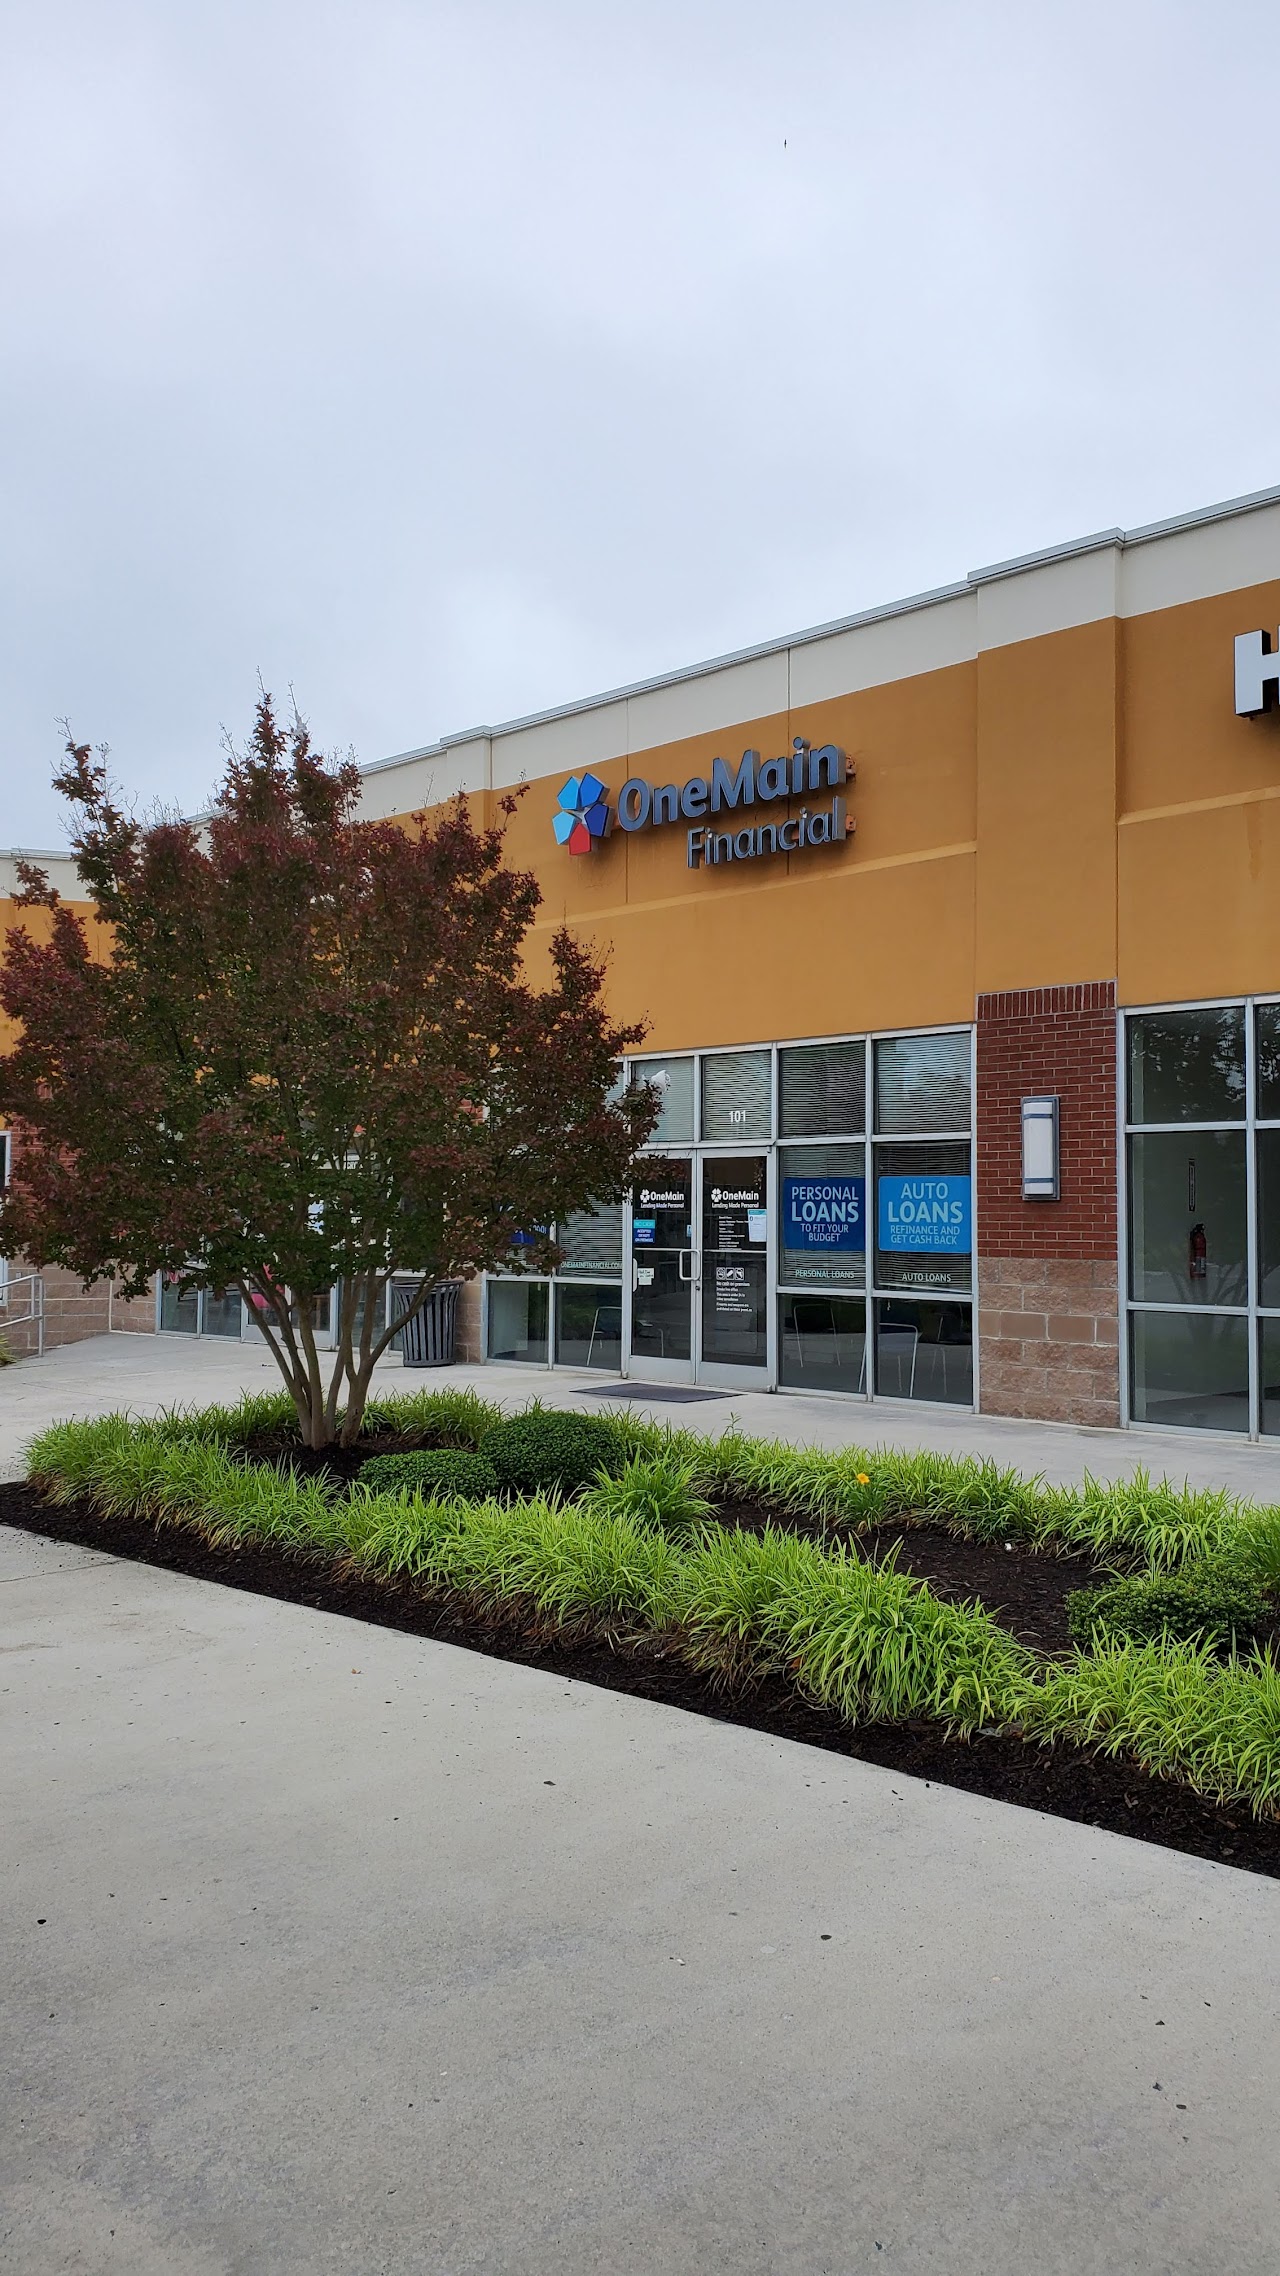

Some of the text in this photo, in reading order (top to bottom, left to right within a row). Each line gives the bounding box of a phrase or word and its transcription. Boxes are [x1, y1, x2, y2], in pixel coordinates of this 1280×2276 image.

[617, 737, 844, 832] OneMain
[687, 796, 845, 868] Financial
[729, 1110, 746, 1123] 101
[650, 1191, 685, 1201] OneMain
[722, 1190, 759, 1201] OneMain
[791, 1186, 859, 1201] PERSONAL
[900, 1182, 949, 1200] AUTO
[791, 1201, 859, 1223] LOANS
[888, 1200, 963, 1224] LOANS
[800, 1223, 849, 1234] TO FIT YOUR
[890, 1224, 960, 1236] REFINANCE AND
[808, 1232, 841, 1242] BUDGET
[890, 1234, 958, 1246] GET CASH BACK
[795, 1269, 855, 1279] PERSONAL LOANS
[901, 1272, 952, 1283] AUTO LOANS
